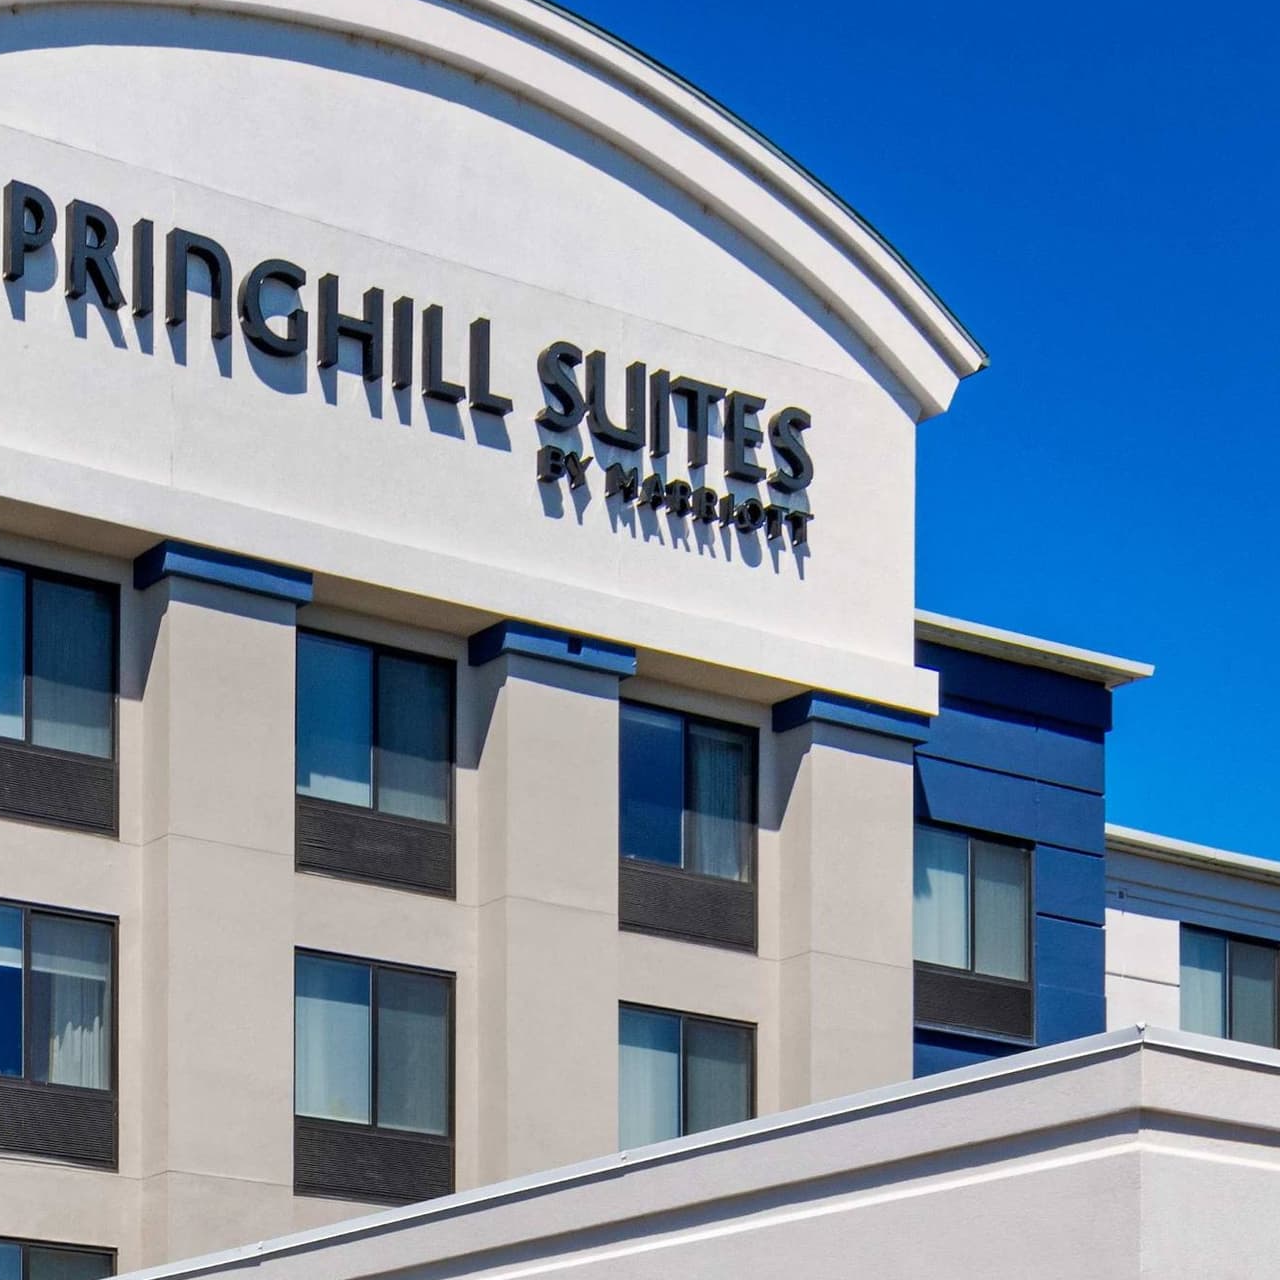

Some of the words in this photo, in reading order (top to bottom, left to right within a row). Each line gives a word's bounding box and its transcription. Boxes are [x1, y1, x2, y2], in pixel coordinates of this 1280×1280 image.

[536, 340, 814, 495] SUITES
[536, 444, 594, 490] BY
[605, 462, 814, 547] MARRIOTT
